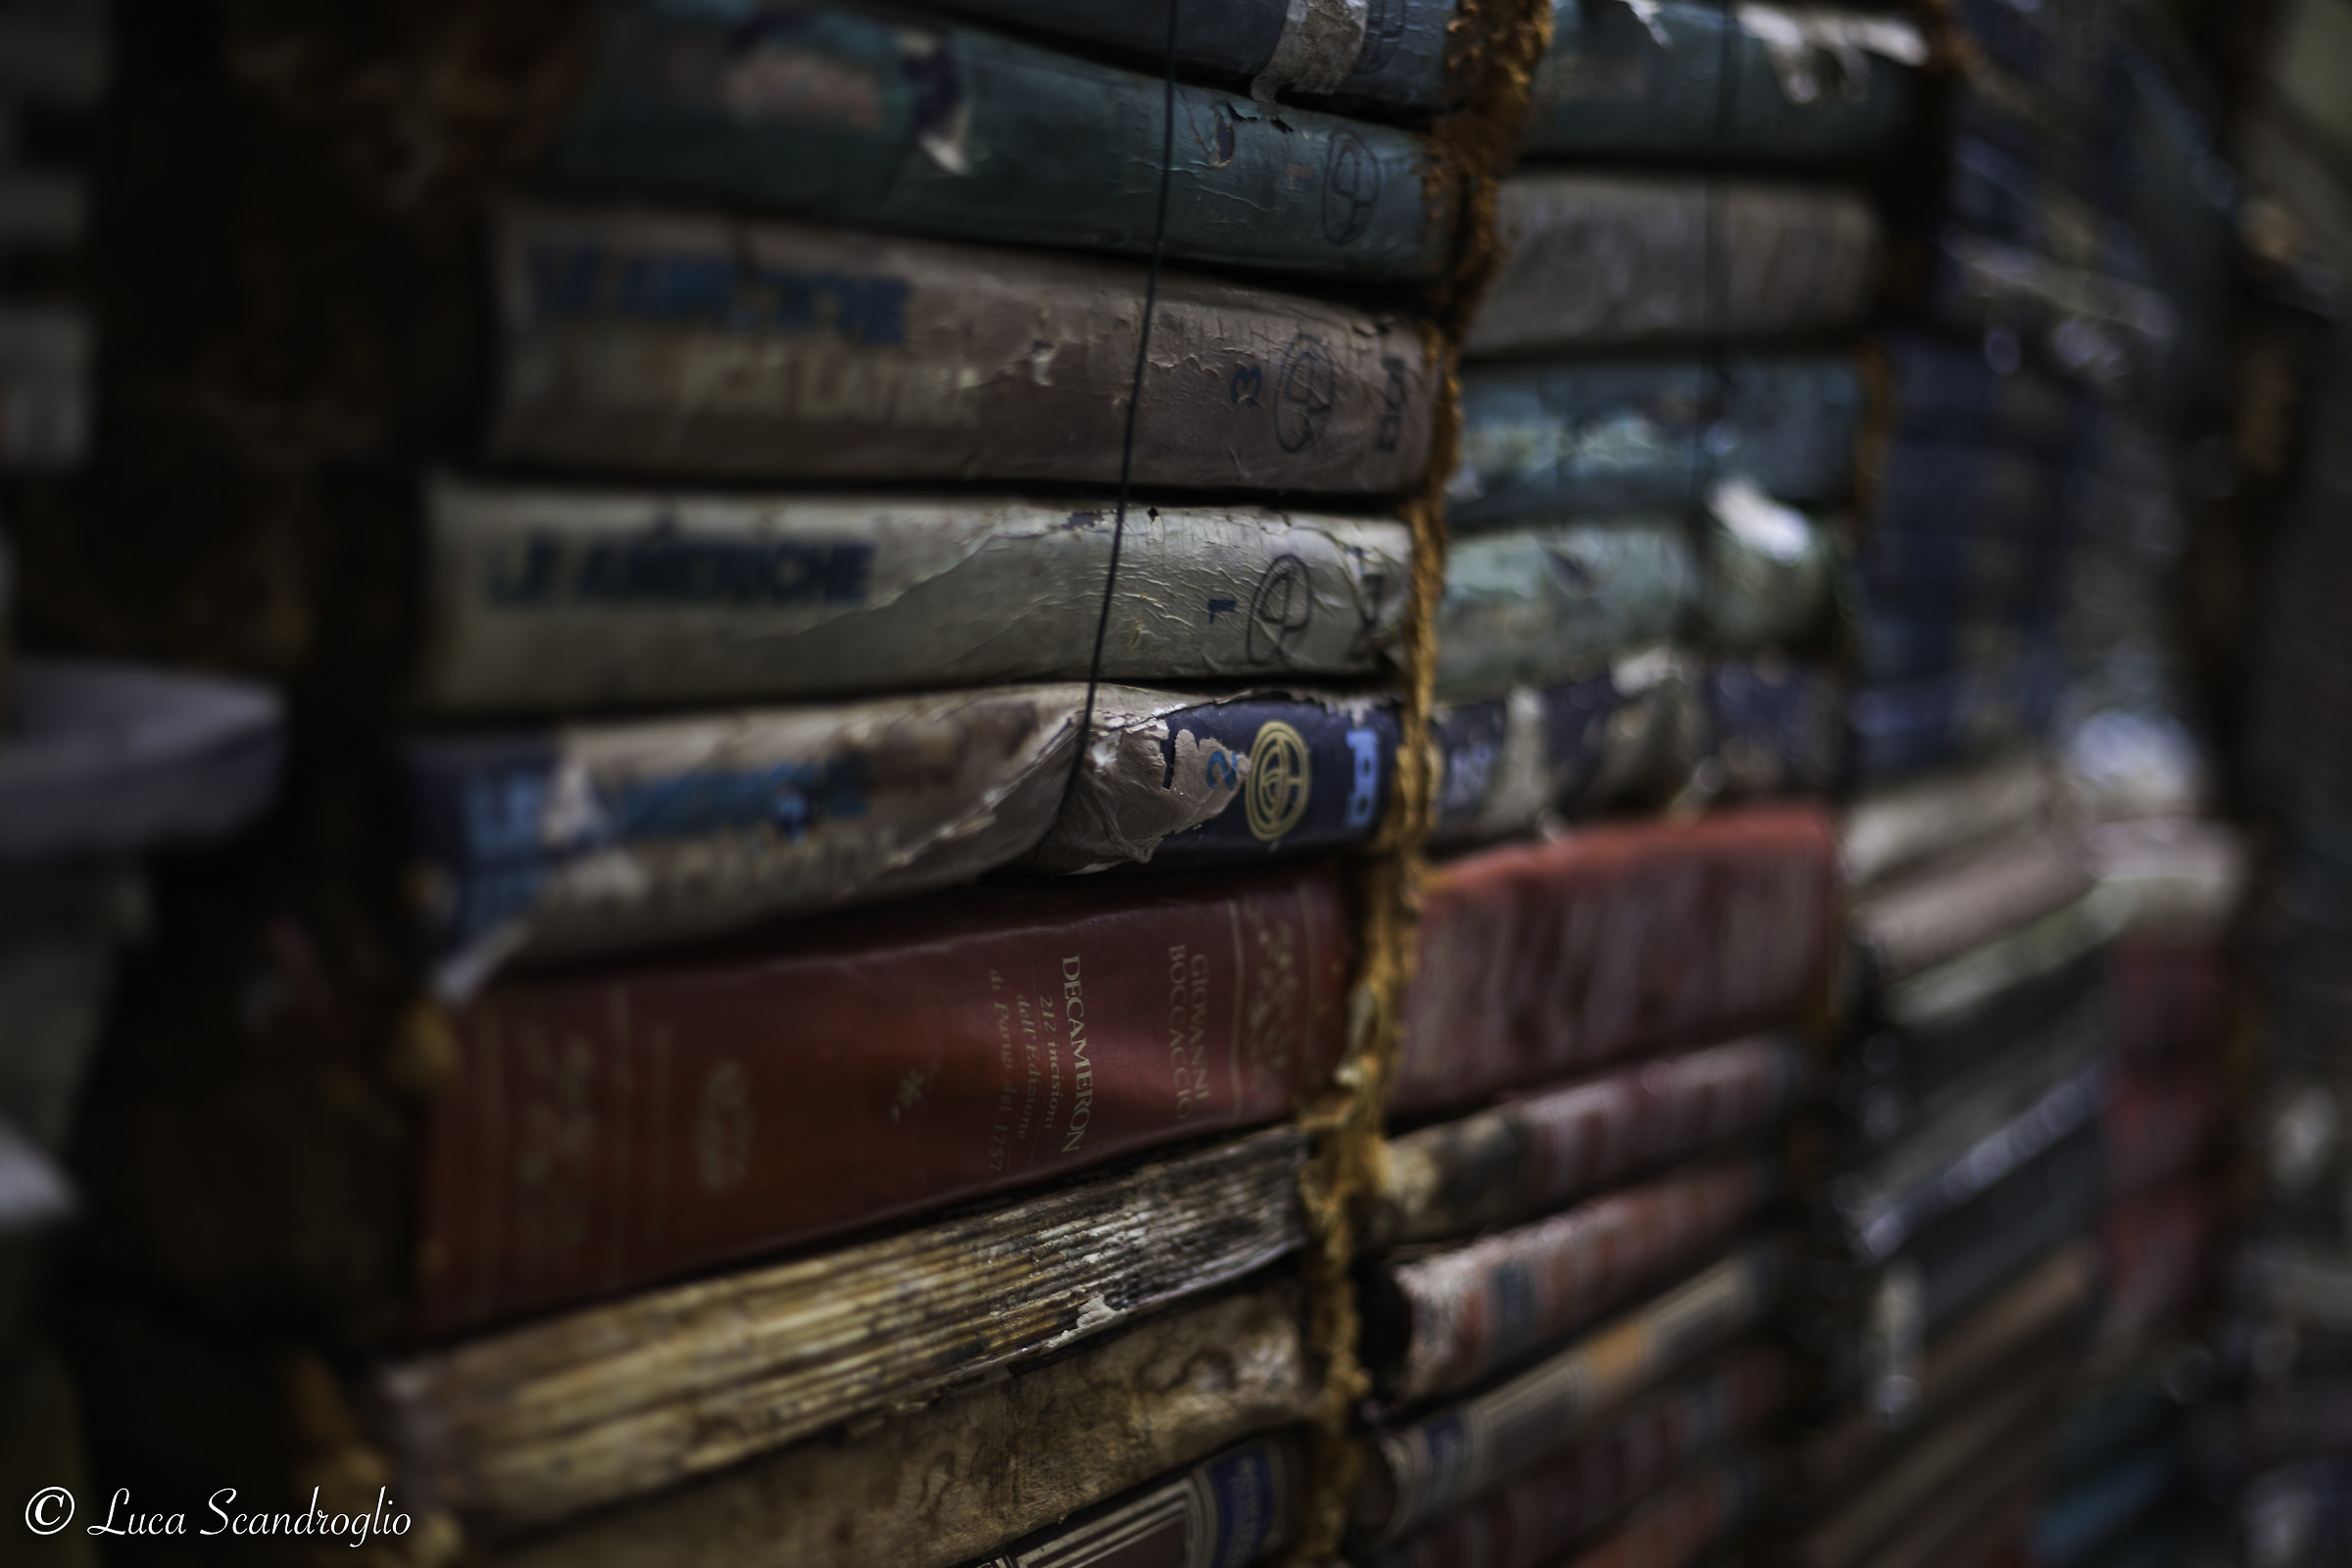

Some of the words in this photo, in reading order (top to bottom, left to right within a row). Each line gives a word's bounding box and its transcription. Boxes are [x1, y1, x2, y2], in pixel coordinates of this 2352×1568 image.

[1231, 366, 1261, 408] 3
[1208, 599, 1236, 625] 1
[1206, 750, 1238, 791] 2
[1040, 995, 1057, 1033] 212
[1168, 945, 1193, 1119] BOCCACCIO
[1191, 954, 1211, 1102] GIOVANNI
[1061, 954, 1094, 1152] DECAMERON
[1043, 1042, 1065, 1130] incisioni
